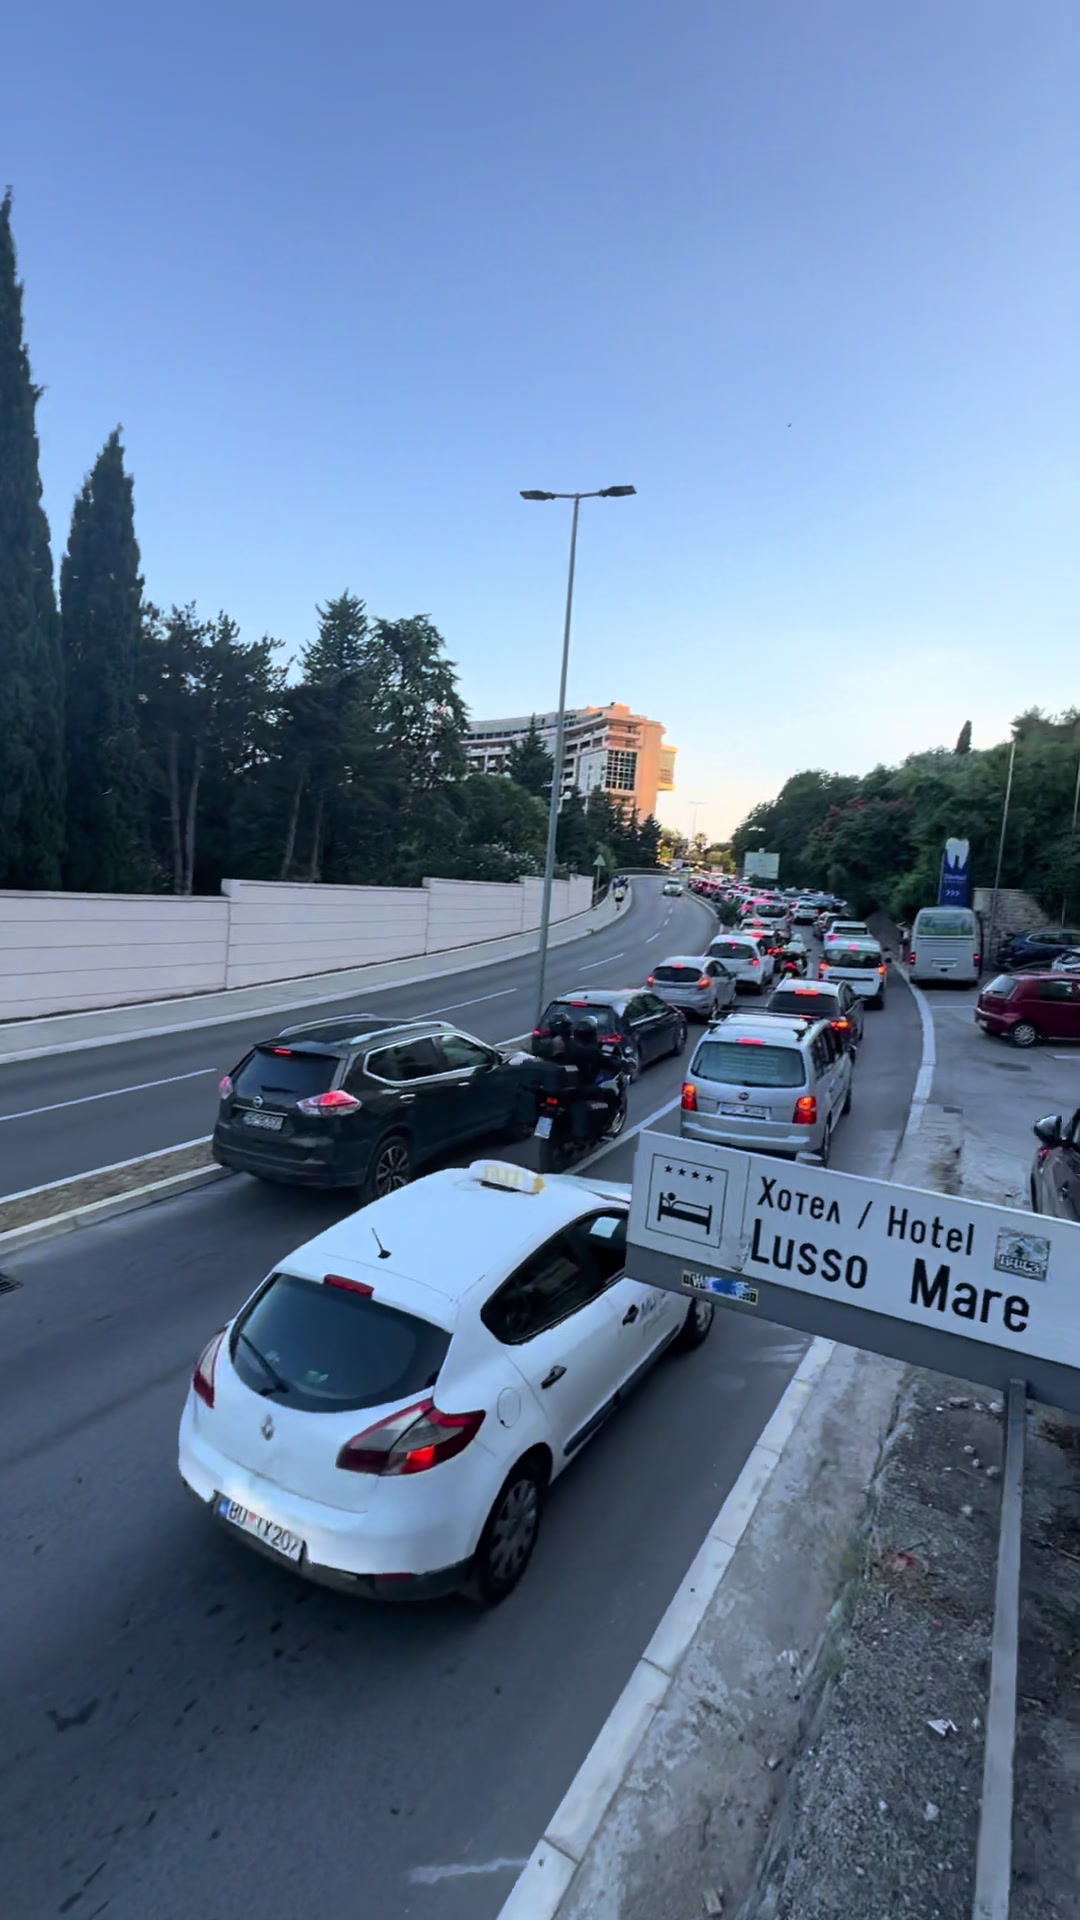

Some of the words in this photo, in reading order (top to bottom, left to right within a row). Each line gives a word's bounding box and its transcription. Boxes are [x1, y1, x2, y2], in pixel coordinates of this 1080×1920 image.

[757, 1175, 841, 1225] Хотел
[857, 1200, 873, 1230] /
[886, 1205, 975, 1256] Hotel
[750, 1217, 869, 1289] Lusso
[909, 1258, 1031, 1333] Mare
